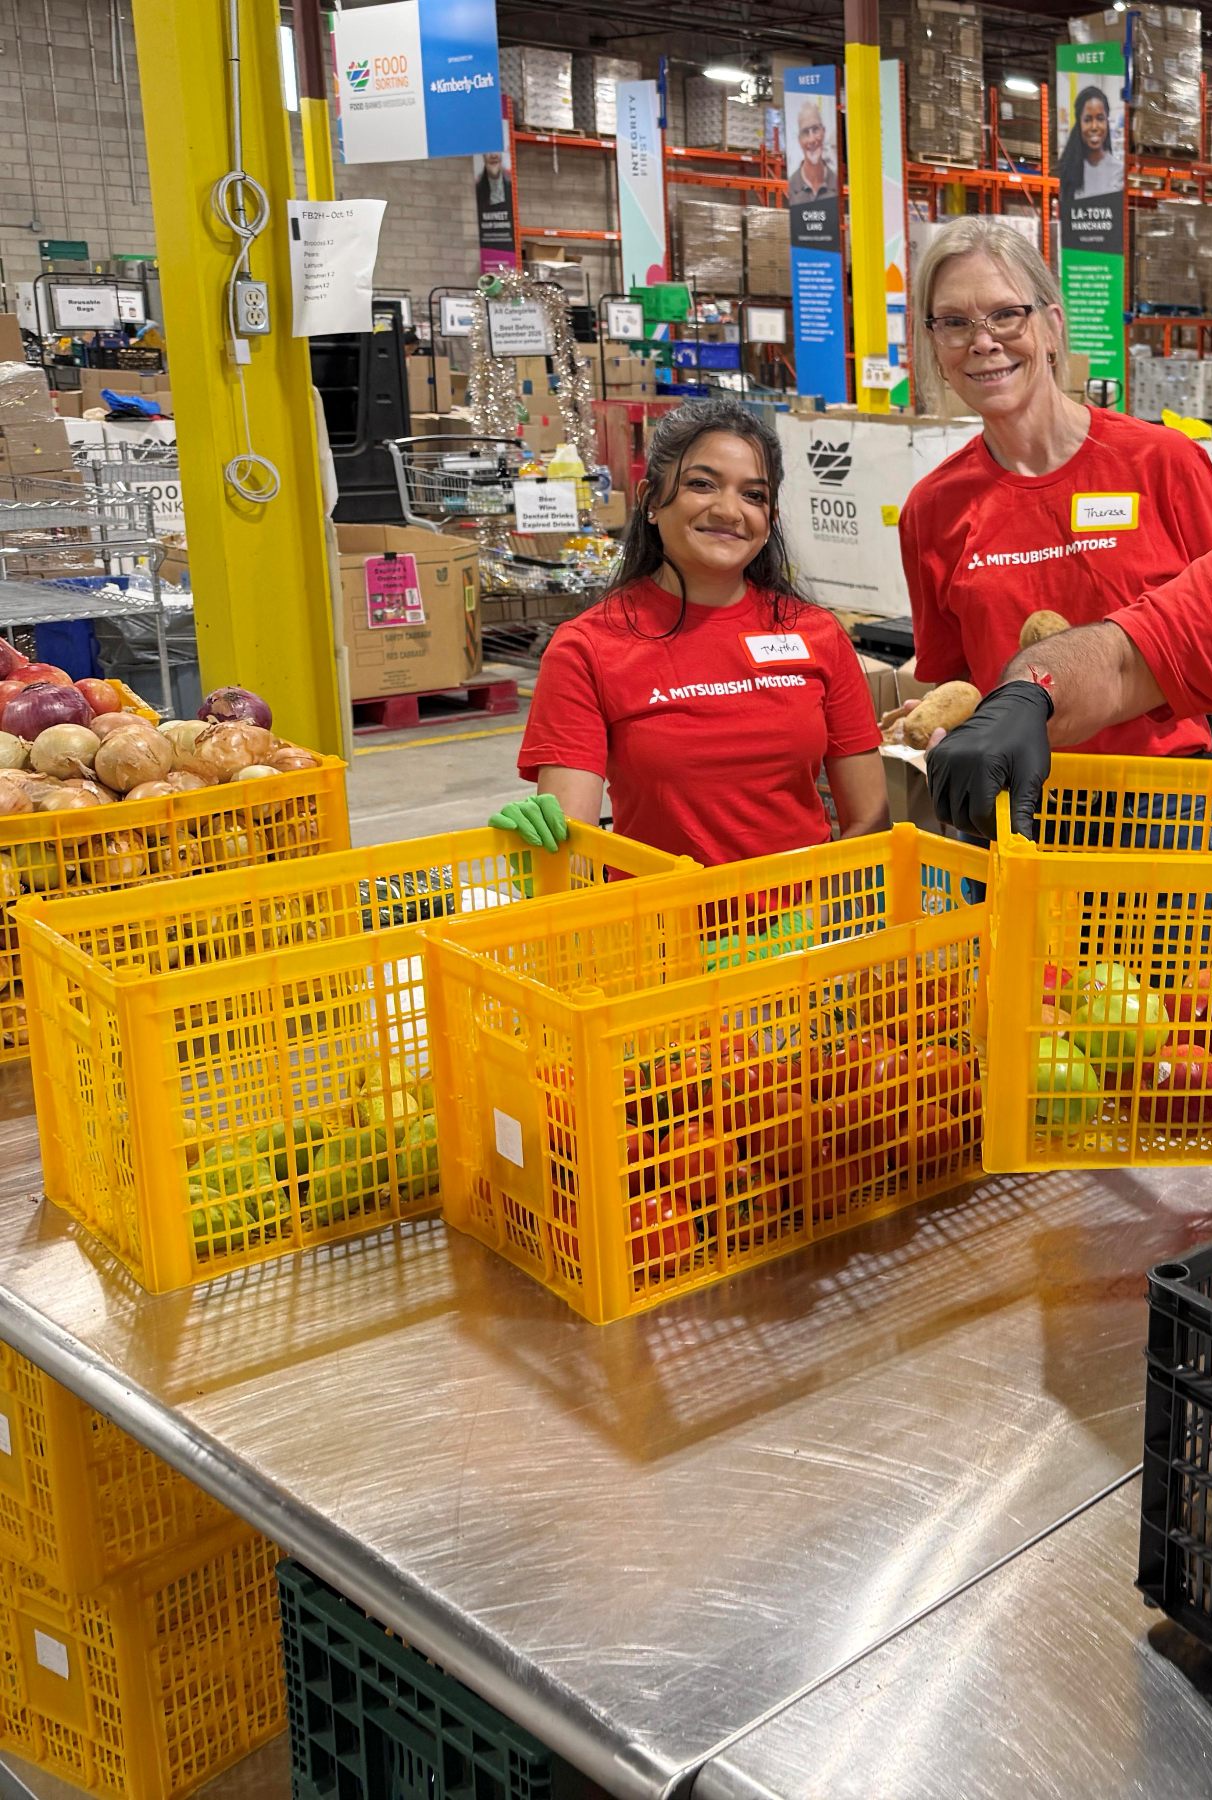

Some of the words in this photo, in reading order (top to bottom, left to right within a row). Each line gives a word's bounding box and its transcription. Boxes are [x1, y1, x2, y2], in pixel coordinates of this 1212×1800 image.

[374, 56, 408, 75] FOOD
[1076, 51, 1105, 64] MEET
[374, 76, 409, 91] SORTING
[437, 73, 494, 93] Kimberly-Clark
[798, 74, 821, 85] MEET
[629, 95, 639, 176] INTEGRITY
[639, 133, 648, 176] FIRST
[302, 211, 325, 220] FB2H
[802, 210, 826, 221] CHRIS
[1071, 207, 1113, 220] LA-TOYA
[1071, 220, 1113, 231] HANCHARD
[810, 497, 857, 519] FOOD
[1084, 507, 1127, 518] Theresa
[812, 516, 859, 536] BANKS
[986, 546, 1064, 566] MITSUBISHI
[1065, 537, 1118, 556] MOTORS
[668, 679, 753, 700] MITSUBISHI
[755, 674, 807, 690] MOTORS
